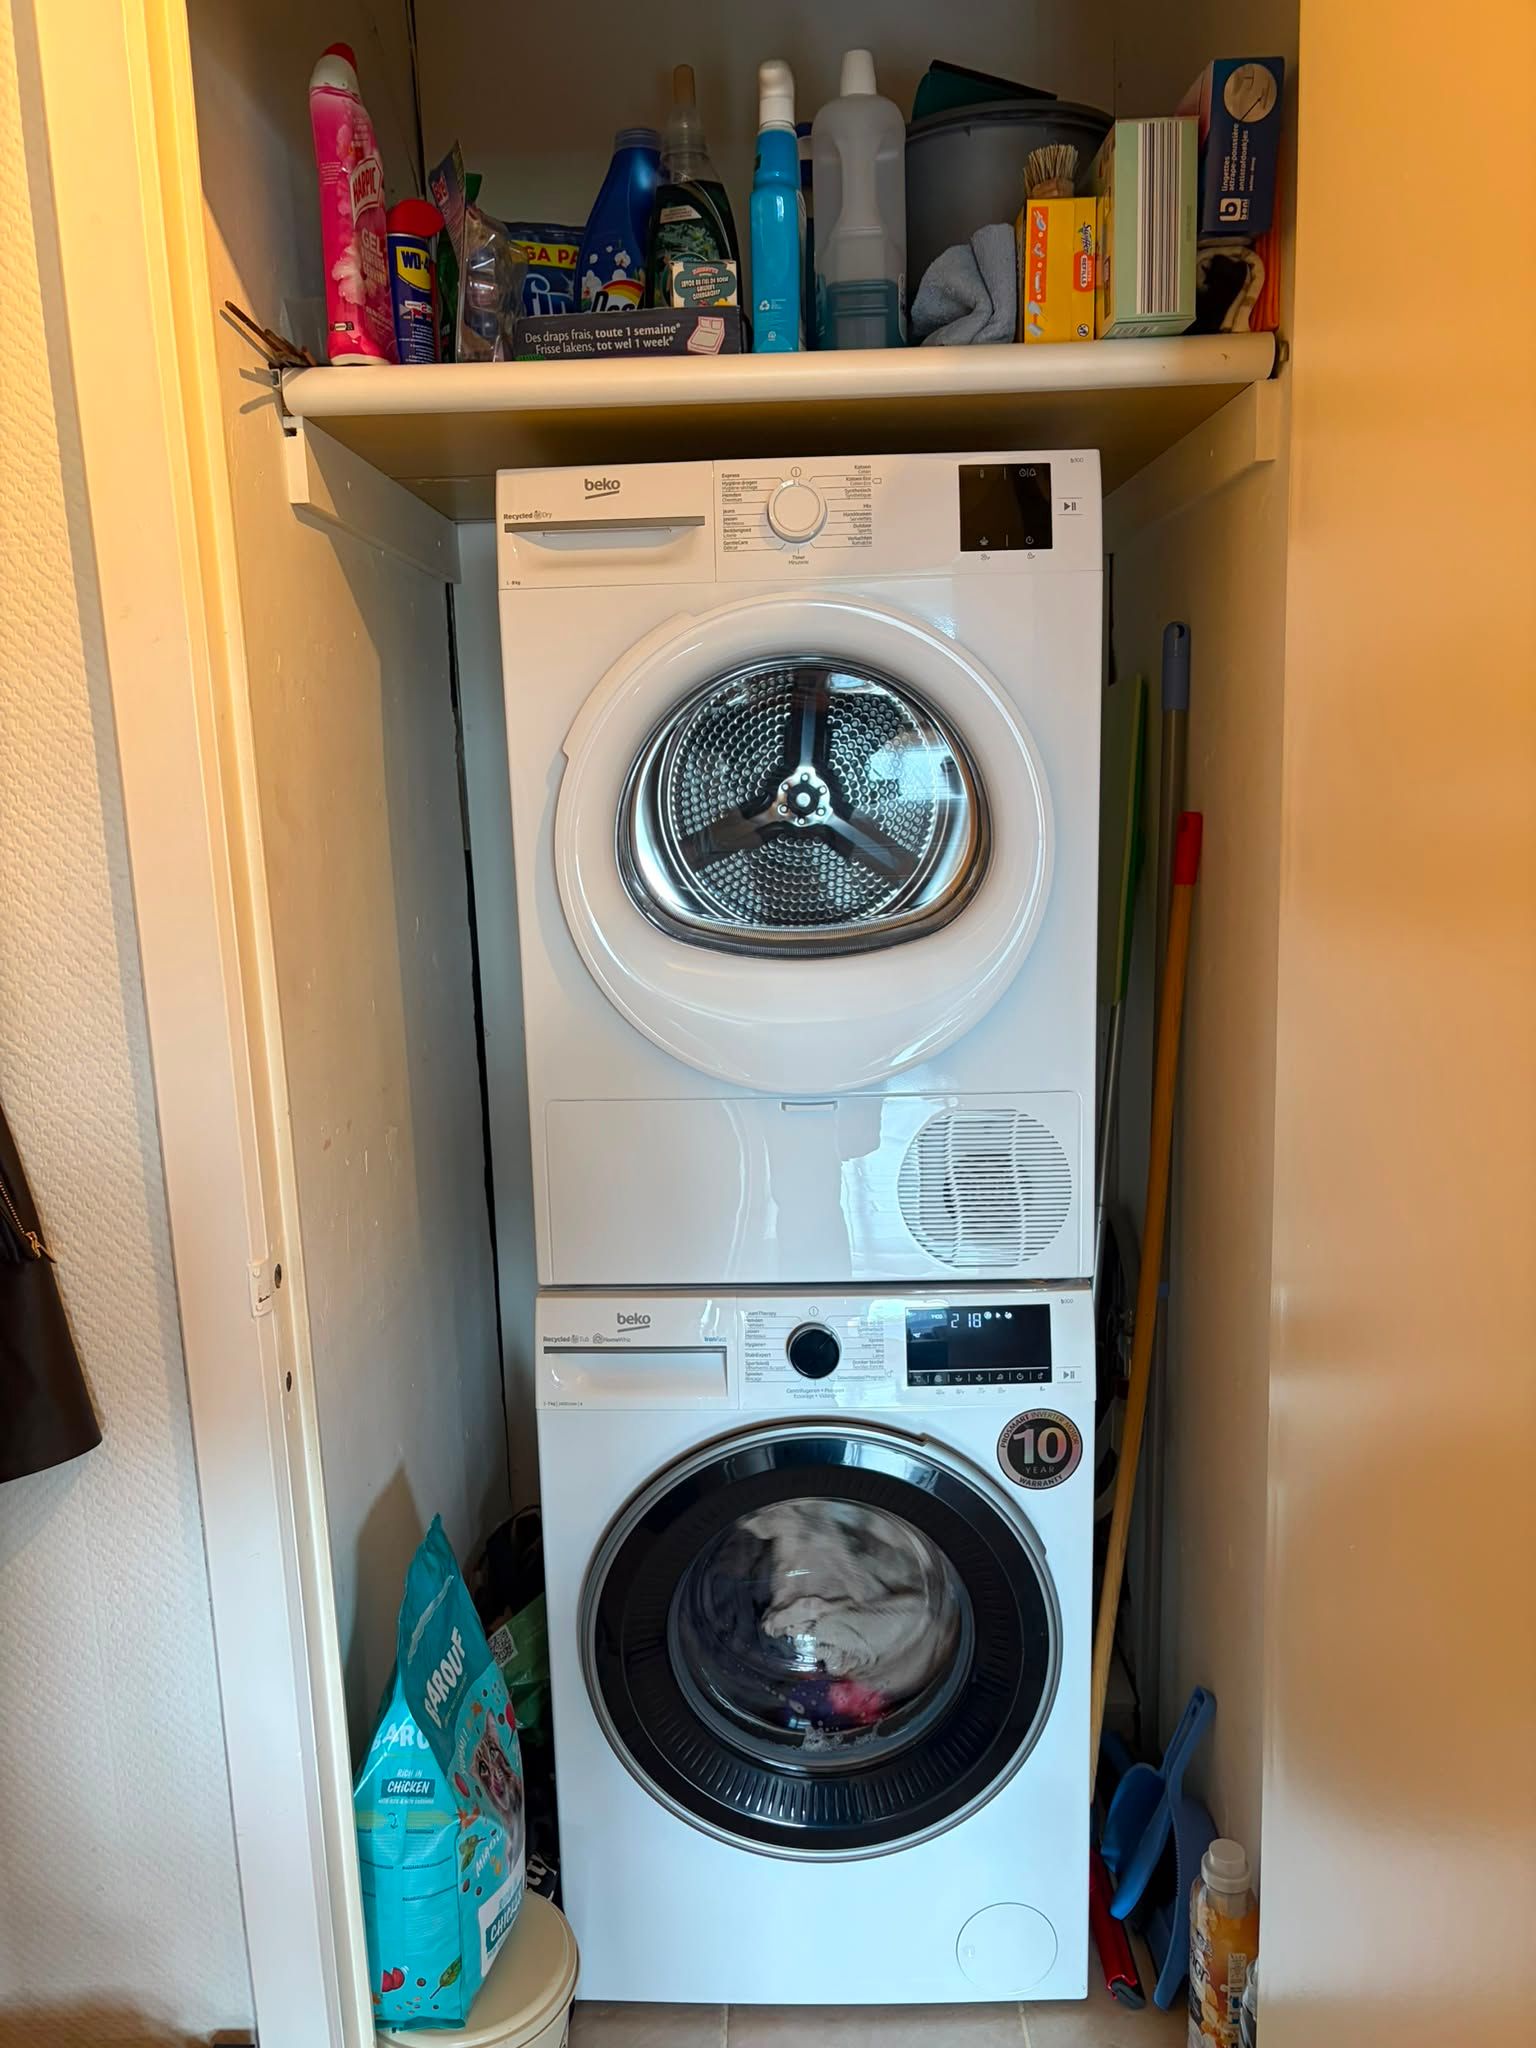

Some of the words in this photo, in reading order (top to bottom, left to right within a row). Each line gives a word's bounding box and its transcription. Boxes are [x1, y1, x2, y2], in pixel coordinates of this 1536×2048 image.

[353, 166, 377, 204] HARPIC
[362, 227, 383, 257] GEL
[525, 333, 542, 343] Des
[543, 329, 569, 343] draps
[571, 329, 593, 341] frais,
[595, 327, 623, 338] toute
[626, 327, 631, 336] 1
[535, 344, 561, 355] Frisse
[562, 342, 595, 354] lakens,
[596, 341, 611, 351] tot
[612, 339, 632, 349] wel
[584, 477, 621, 491] beko
[503, 511, 533, 520] Recycled
[617, 1313, 651, 1325] beko
[543, 1335, 570, 1344] Recycled
[1000, 1414, 1030, 1448] PROSMART
[1030, 1411, 1066, 1423] INVERTER
[1013, 1427, 1067, 1464] 10
[1025, 1466, 1056, 1474] YEAR
[1019, 1474, 1063, 1487] WARRANTY
[424, 1626, 466, 1729] BAROUF
